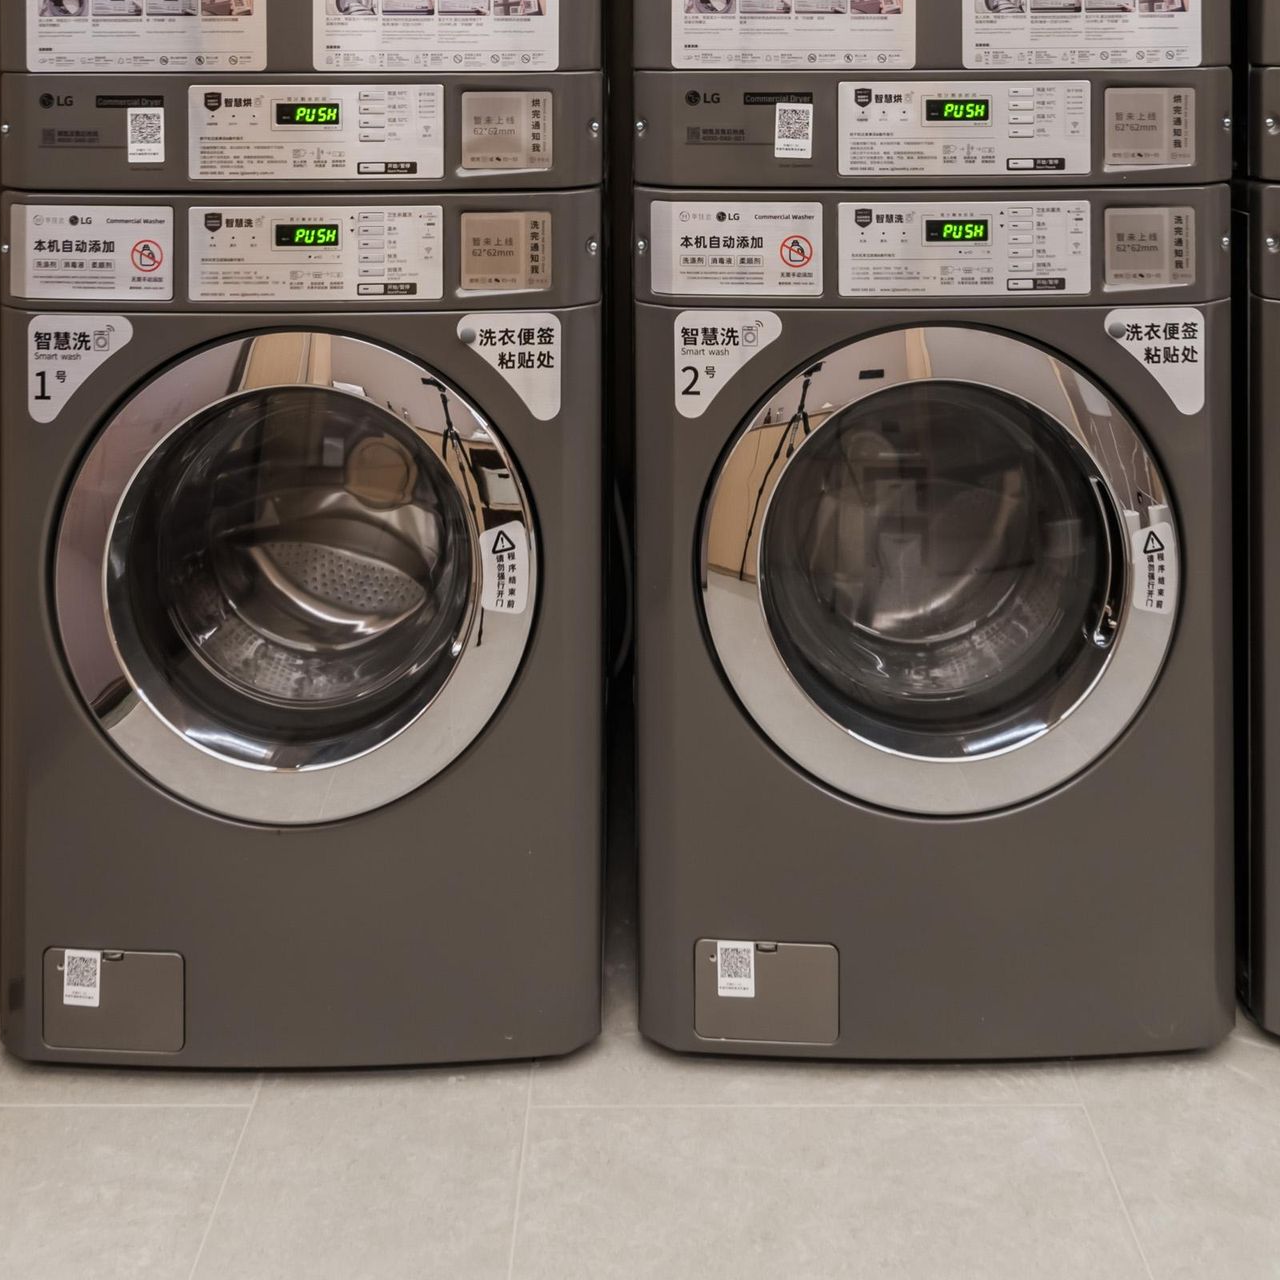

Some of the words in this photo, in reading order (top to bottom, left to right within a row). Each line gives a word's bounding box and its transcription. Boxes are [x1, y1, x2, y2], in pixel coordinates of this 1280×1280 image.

[57, 96, 73, 106] LG
[224, 98, 252, 107] 智慧烘
[703, 93, 720, 104] LG
[745, 95, 789, 103] Commercial
[790, 95, 811, 104] Dryer
[875, 94, 902, 103] 智慧烘
[296, 107, 337, 122] PUSH
[944, 104, 985, 118] PUSH
[80, 216, 92, 225] LG
[225, 218, 253, 228] 智慧洗
[728, 213, 740, 221] LG
[876, 214, 904, 223] 智慧洗
[295, 229, 337, 243] PUSH
[943, 224, 984, 238] PUSH
[33, 239, 115, 253] 本机自动添加
[680, 235, 763, 249] 本机自动添加
[479, 327, 555, 346] 洗衣便签
[681, 326, 740, 346] 智慧洗
[1126, 322, 1199, 341] 洗衣便签
[34, 331, 91, 351] 智慧洗
[34, 352, 58, 361] Smart
[61, 352, 81, 361] wash
[681, 347, 706, 356] Smart
[708, 348, 730, 356] wash
[1143, 346, 1199, 364] 粘贴处
[498, 351, 555, 369] 粘贴处
[495, 554, 505, 608] 请勿强行开门
[507, 552, 517, 609] 程序结束前
[1156, 552, 1166, 609] 程序结束前
